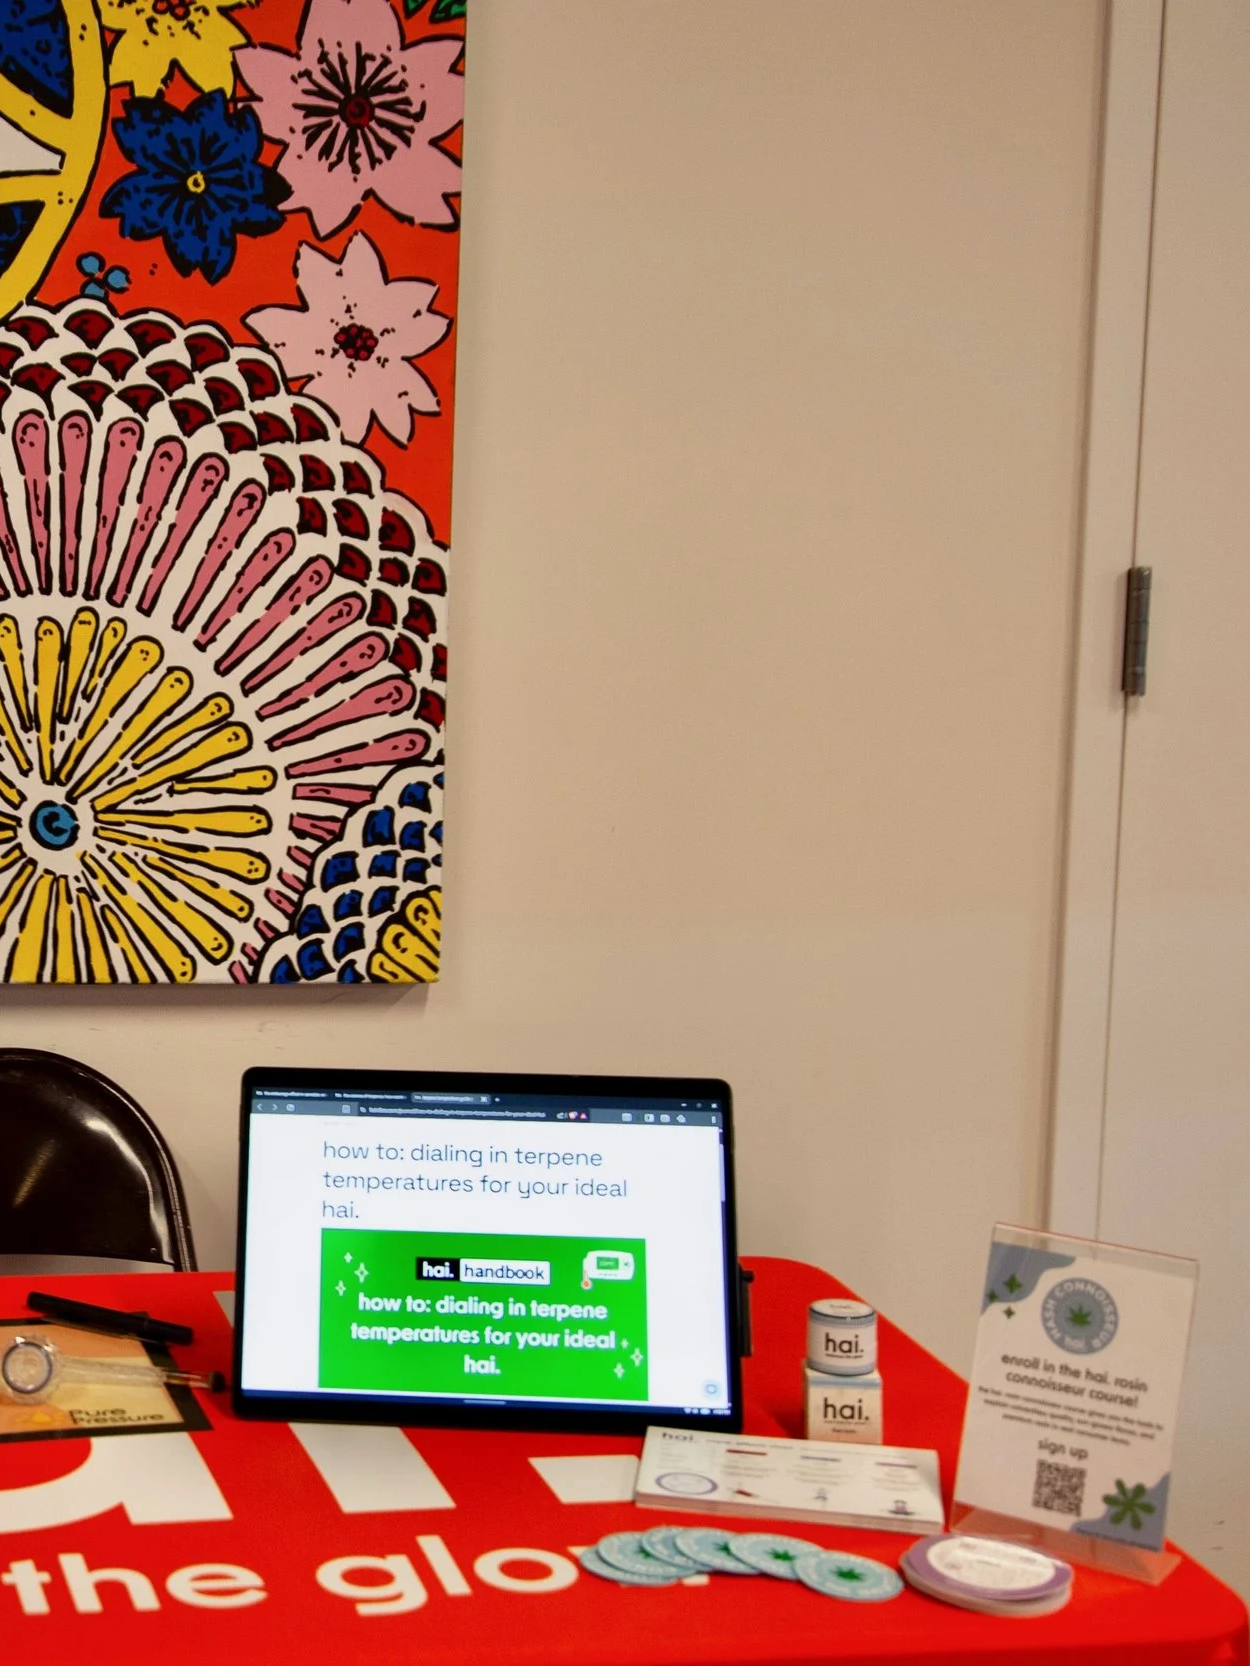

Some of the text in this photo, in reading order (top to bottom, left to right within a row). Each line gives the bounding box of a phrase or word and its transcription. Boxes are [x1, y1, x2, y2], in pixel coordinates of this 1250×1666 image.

[323, 1141, 603, 1169] how to: dialing in terpene
[323, 1171, 627, 1199] temperatures for your ideal
[322, 1200, 359, 1219] hai.
[422, 1260, 545, 1280] hai. handbook
[358, 1291, 609, 1322] how to: dialing in terpene
[350, 1322, 616, 1350] temperatures for your ideal
[824, 1331, 865, 1354] hai.
[463, 1353, 502, 1375] hai.
[1001, 1353, 1040, 1370] enroll
[1043, 1359, 1056, 1373] in
[1059, 1363, 1082, 1379] the
[1114, 1376, 1148, 1393] rosin
[1006, 1371, 1139, 1408] connoisseur course!
[69, 1408, 128, 1418] Pure
[72, 1413, 165, 1425] Pressure
[823, 1397, 869, 1421] hai.
[661, 1432, 698, 1442] hai.
[1038, 1438, 1089, 1461] sign up
[1, 1553, 268, 1615] the
[315, 1534, 710, 1617] glo
